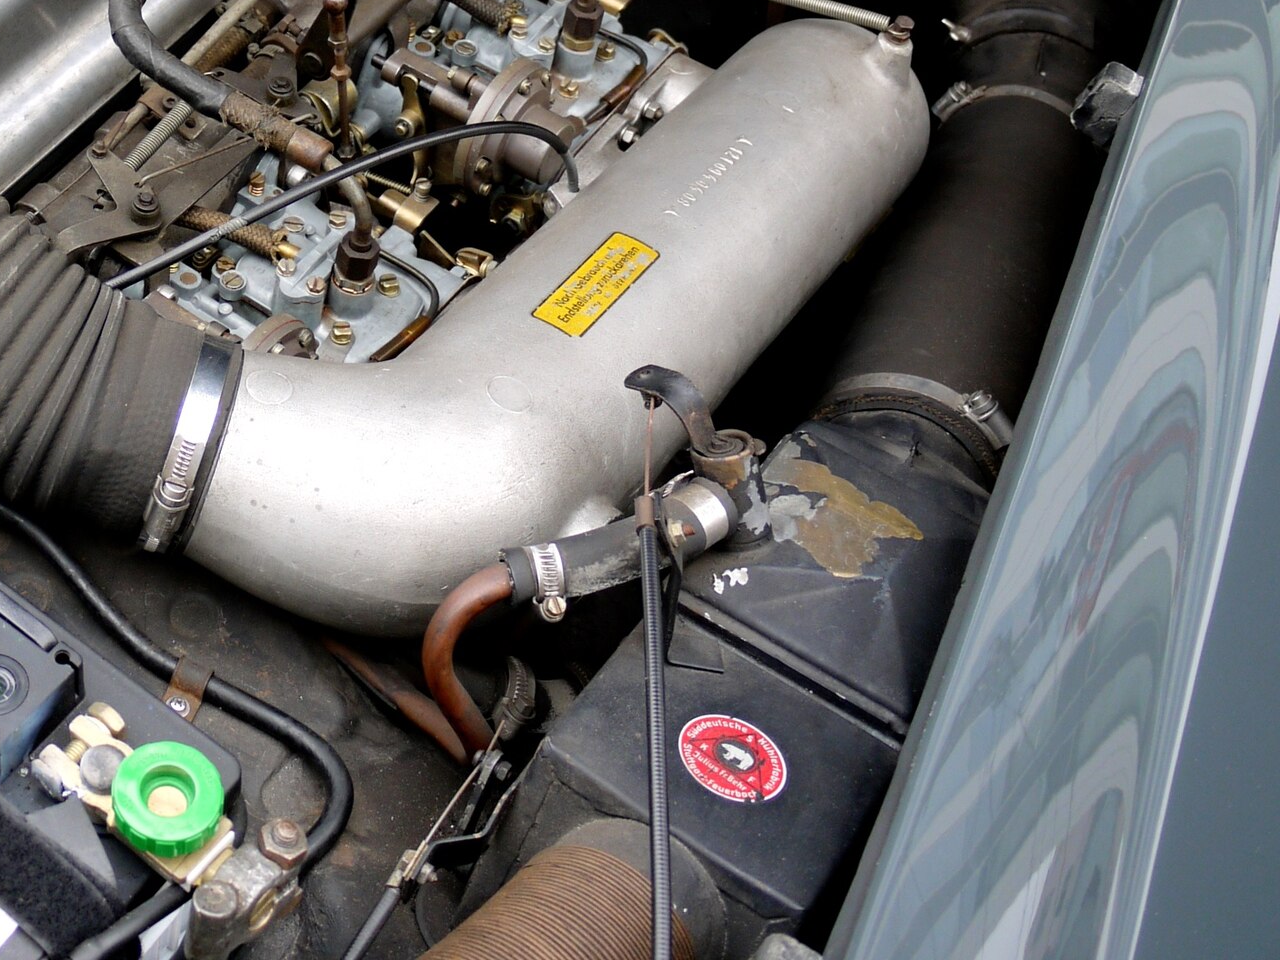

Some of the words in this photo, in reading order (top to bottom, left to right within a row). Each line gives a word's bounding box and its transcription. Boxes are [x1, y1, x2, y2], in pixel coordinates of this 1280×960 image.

[555, 286, 576, 308] Nach
[686, 719, 748, 738] Süddeutsche
[692, 751, 719, 773] Julius
